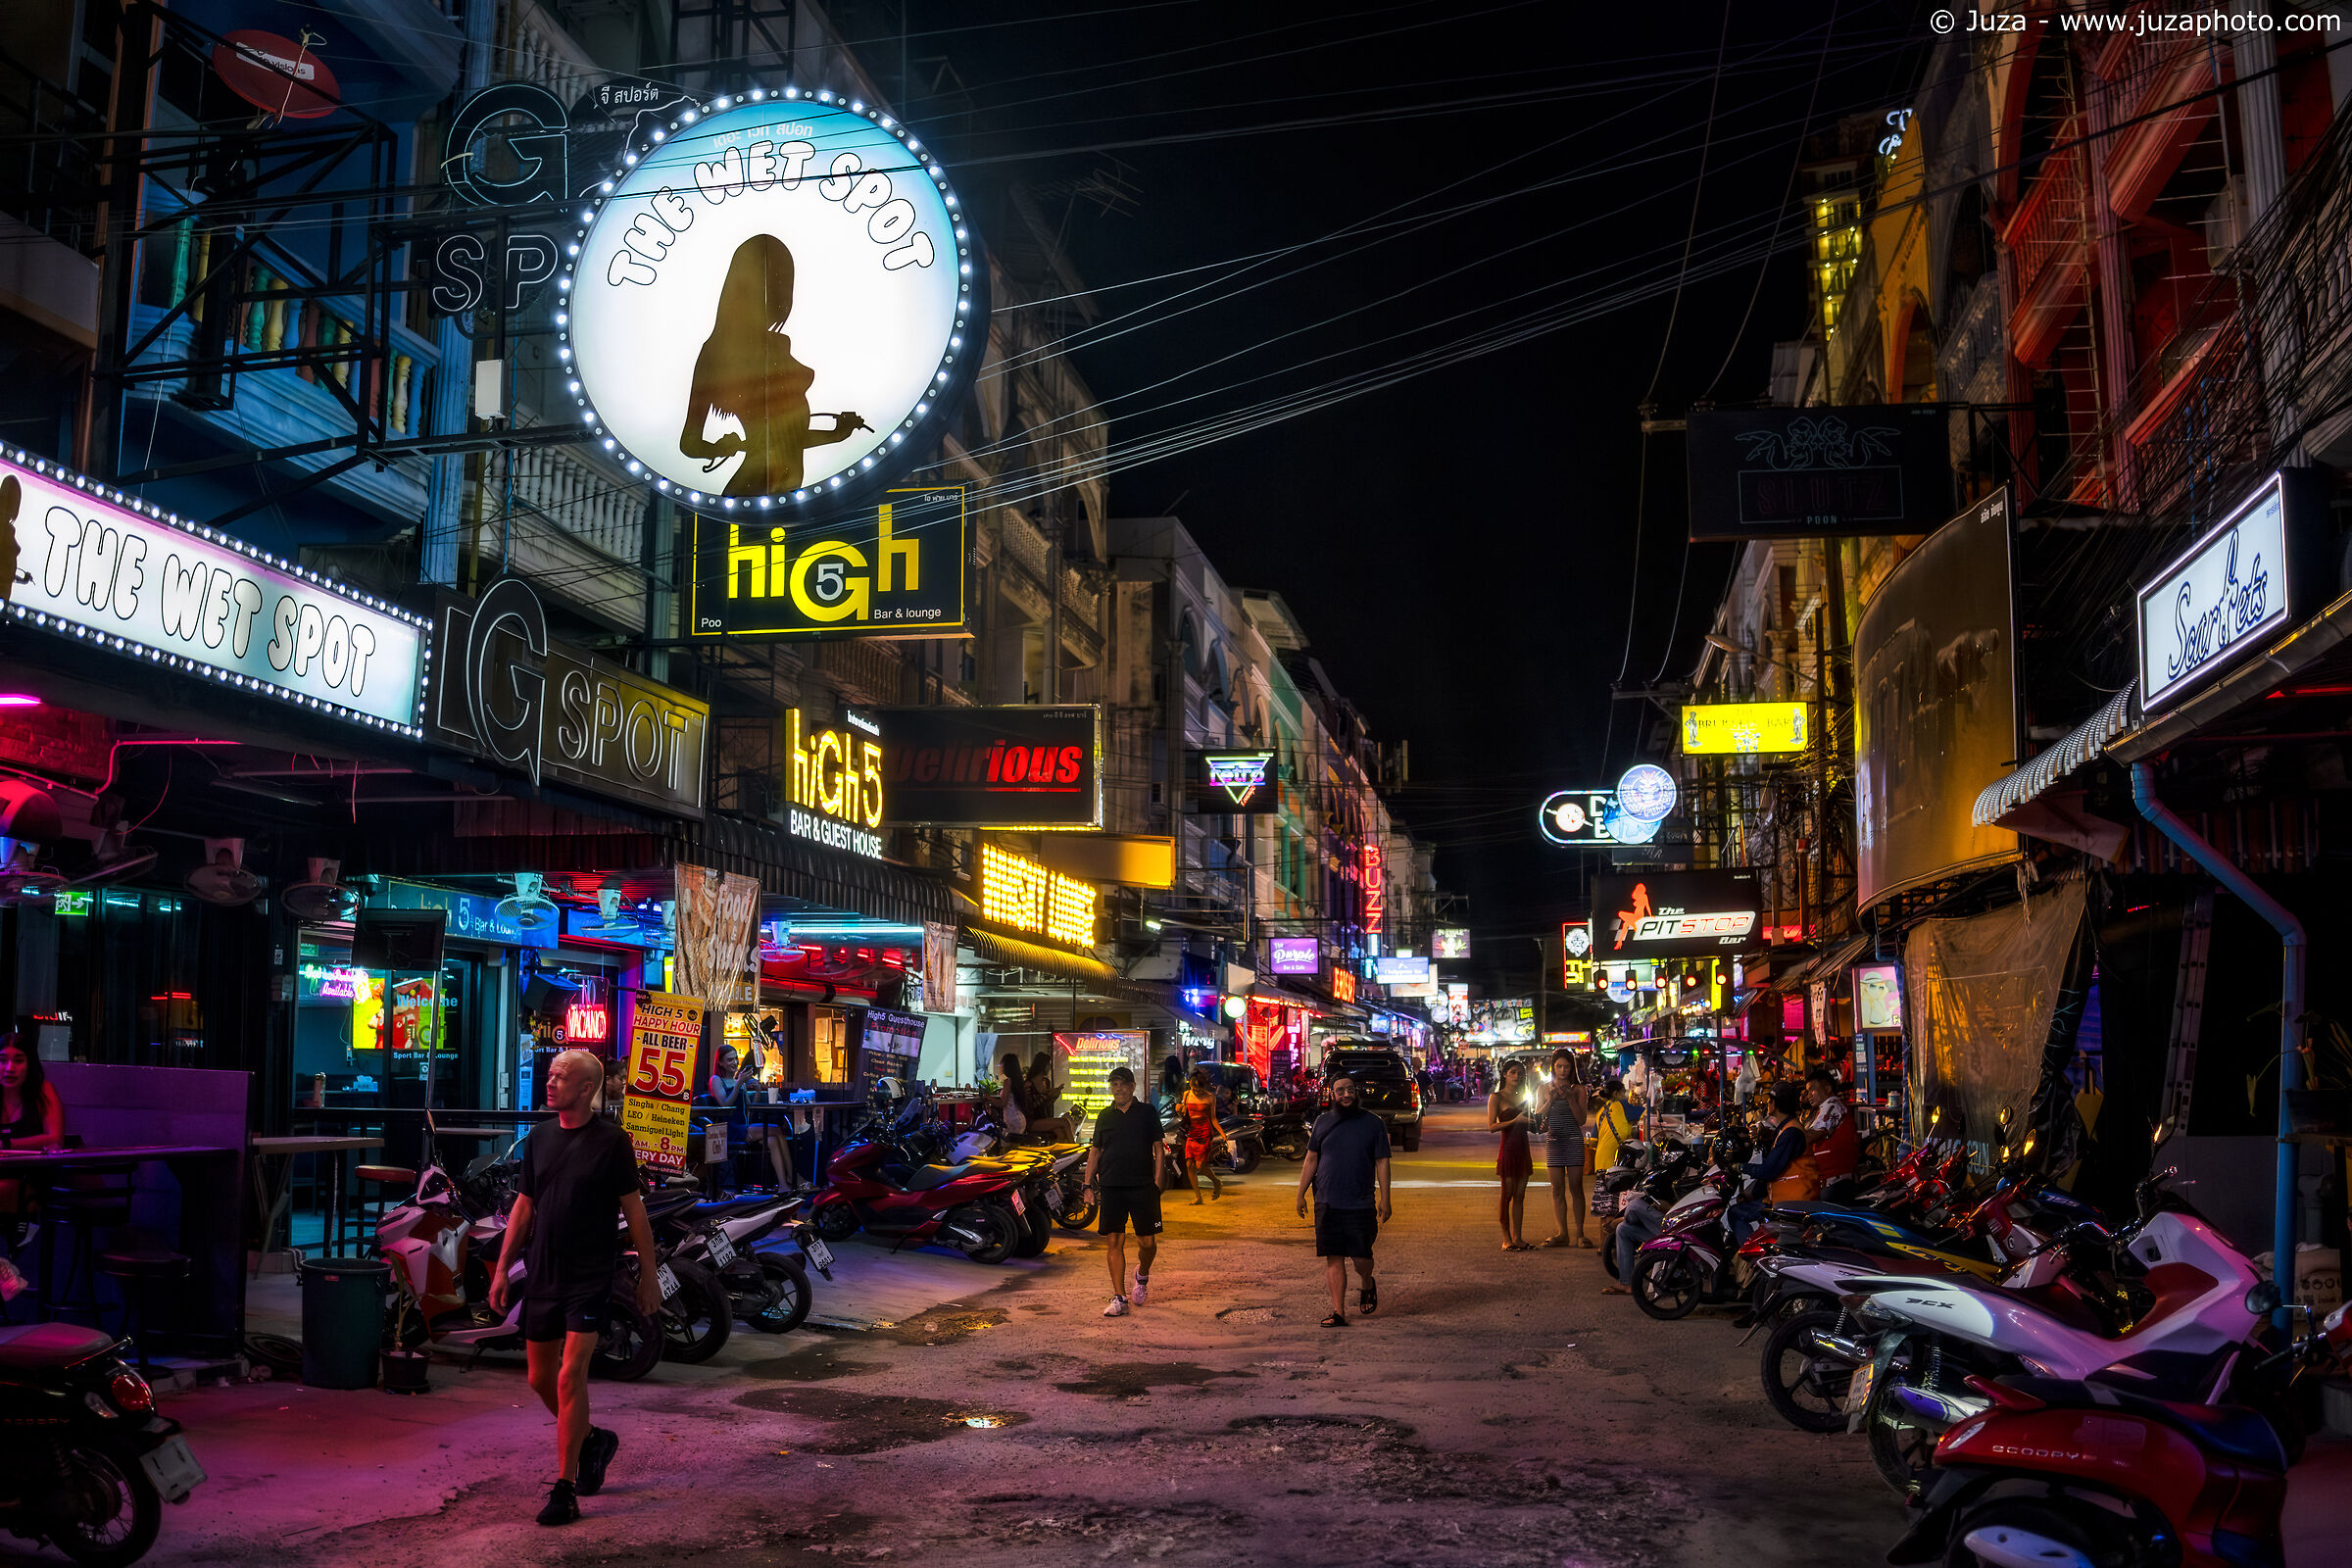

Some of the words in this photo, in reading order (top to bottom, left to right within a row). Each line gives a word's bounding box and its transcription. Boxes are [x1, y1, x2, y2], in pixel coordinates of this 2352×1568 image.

[607, 186, 694, 287] THE
[693, 139, 816, 206] WET
[818, 152, 935, 271] SPOT
[43, 506, 148, 620] THE
[162, 553, 263, 660] WET
[268, 596, 376, 698] SPOT
[874, 609, 893, 620] Bar
[895, 610, 904, 619] &
[906, 608, 941, 621] lounge
[466, 578, 548, 787] G
[558, 669, 688, 791] SPOT
[862, 741, 882, 829] 5
[790, 808, 812, 840] BAR
[820, 817, 852, 852] GUEST
[853, 827, 883, 860] HOUSE
[1364, 845, 1382, 934] BUZZ
[1658, 906, 1686, 915] The
[1719, 936, 1746, 945] Bar
[1274, 948, 1316, 964] Purple
[641, 1004, 673, 1017] HIGH
[674, 1009, 683, 1018] 5
[633, 1014, 669, 1029] HAPPY
[669, 1020, 701, 1035] HOUR
[888, 1013, 925, 1028] Guesthouse
[871, 1021, 917, 1037] Promotion
[642, 1032, 660, 1047] ALL
[661, 1034, 687, 1051] BEER
[393, 1052, 412, 1060] Sport
[633, 1046, 687, 1097] 55
[661, 1103, 685, 1116] Chang
[627, 1110, 643, 1120] LEO
[651, 1113, 685, 1126] Heineken
[625, 1122, 664, 1136] Sanmiguel
[664, 1127, 684, 1139] Light
[660, 1136, 670, 1152] 8
[635, 1150, 658, 1162] ERY
[660, 1152, 683, 1165] DAY
[1992, 1445, 2080, 1459] SCOOPY
